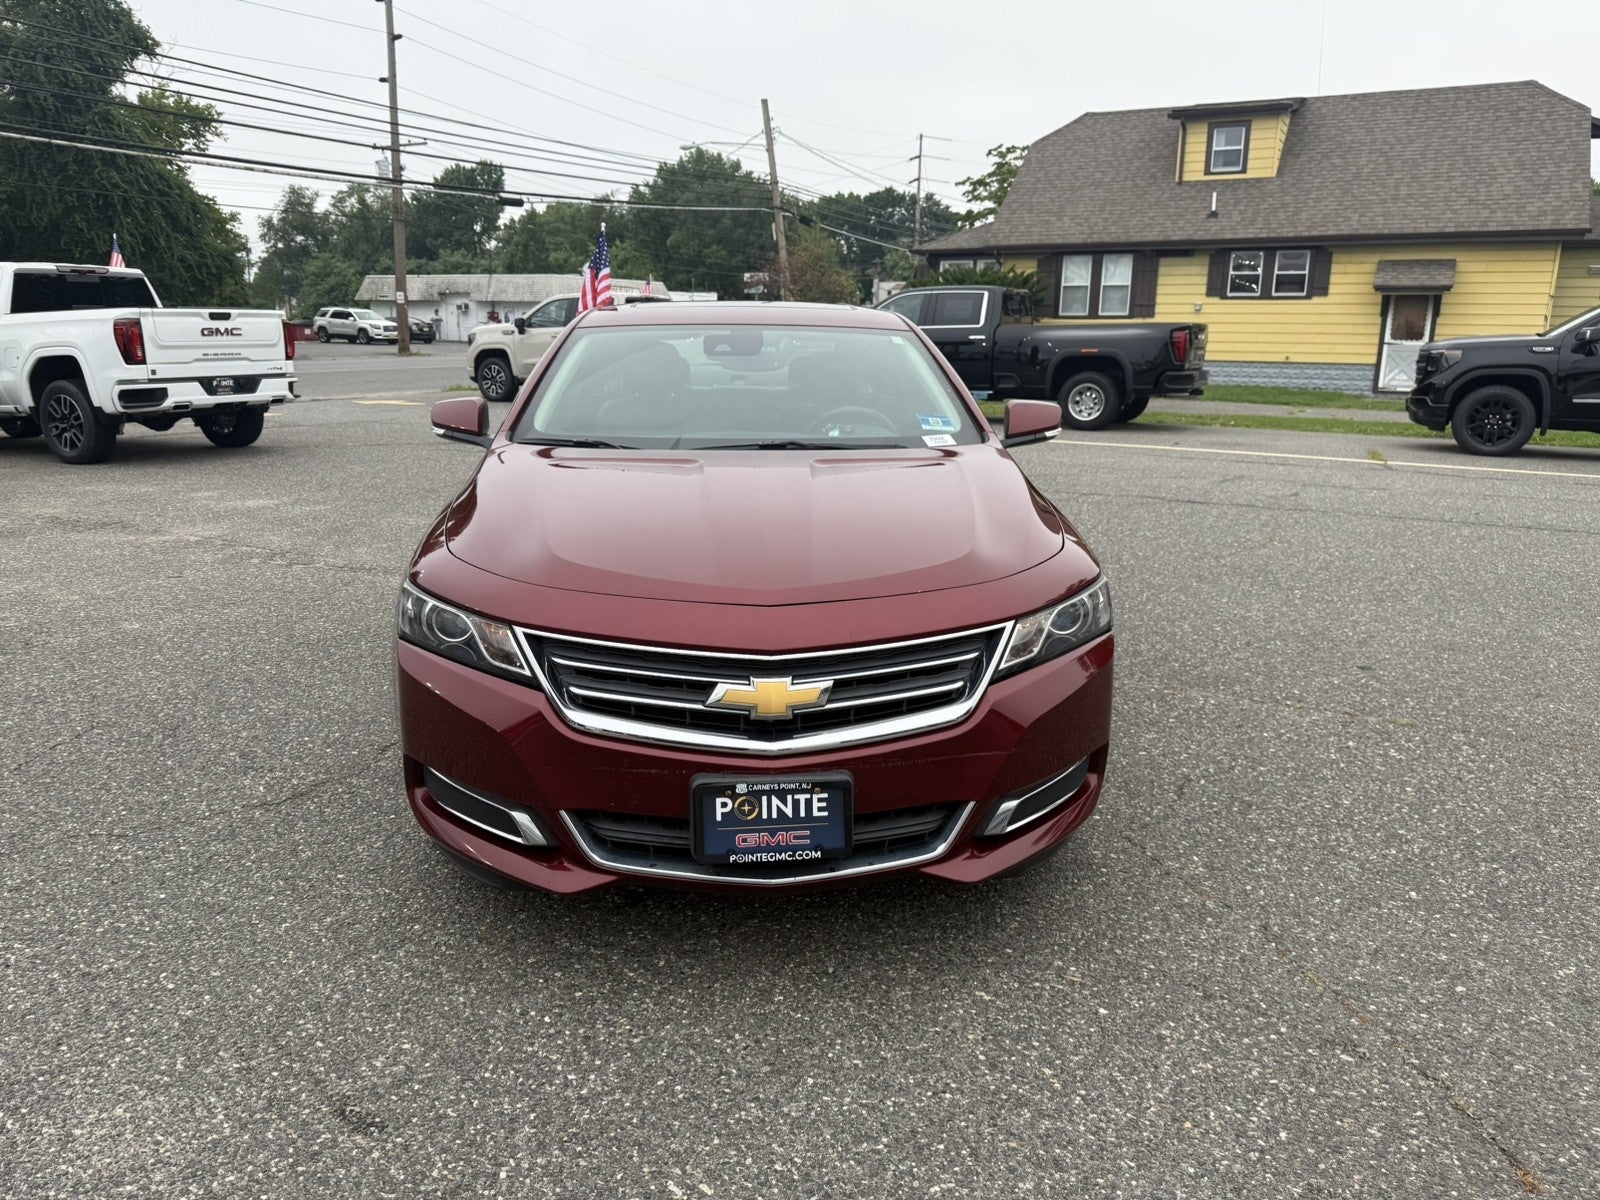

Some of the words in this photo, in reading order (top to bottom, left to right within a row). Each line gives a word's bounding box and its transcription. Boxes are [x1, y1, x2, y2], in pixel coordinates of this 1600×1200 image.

[200, 327, 242, 337] GMC
[748, 783, 779, 791] CARNEYS
[780, 782, 801, 790] POINT,
[715, 792, 829, 822] POINTE
[735, 830, 810, 848] GMC
[729, 851, 822, 863] POINTEGMC.COM
